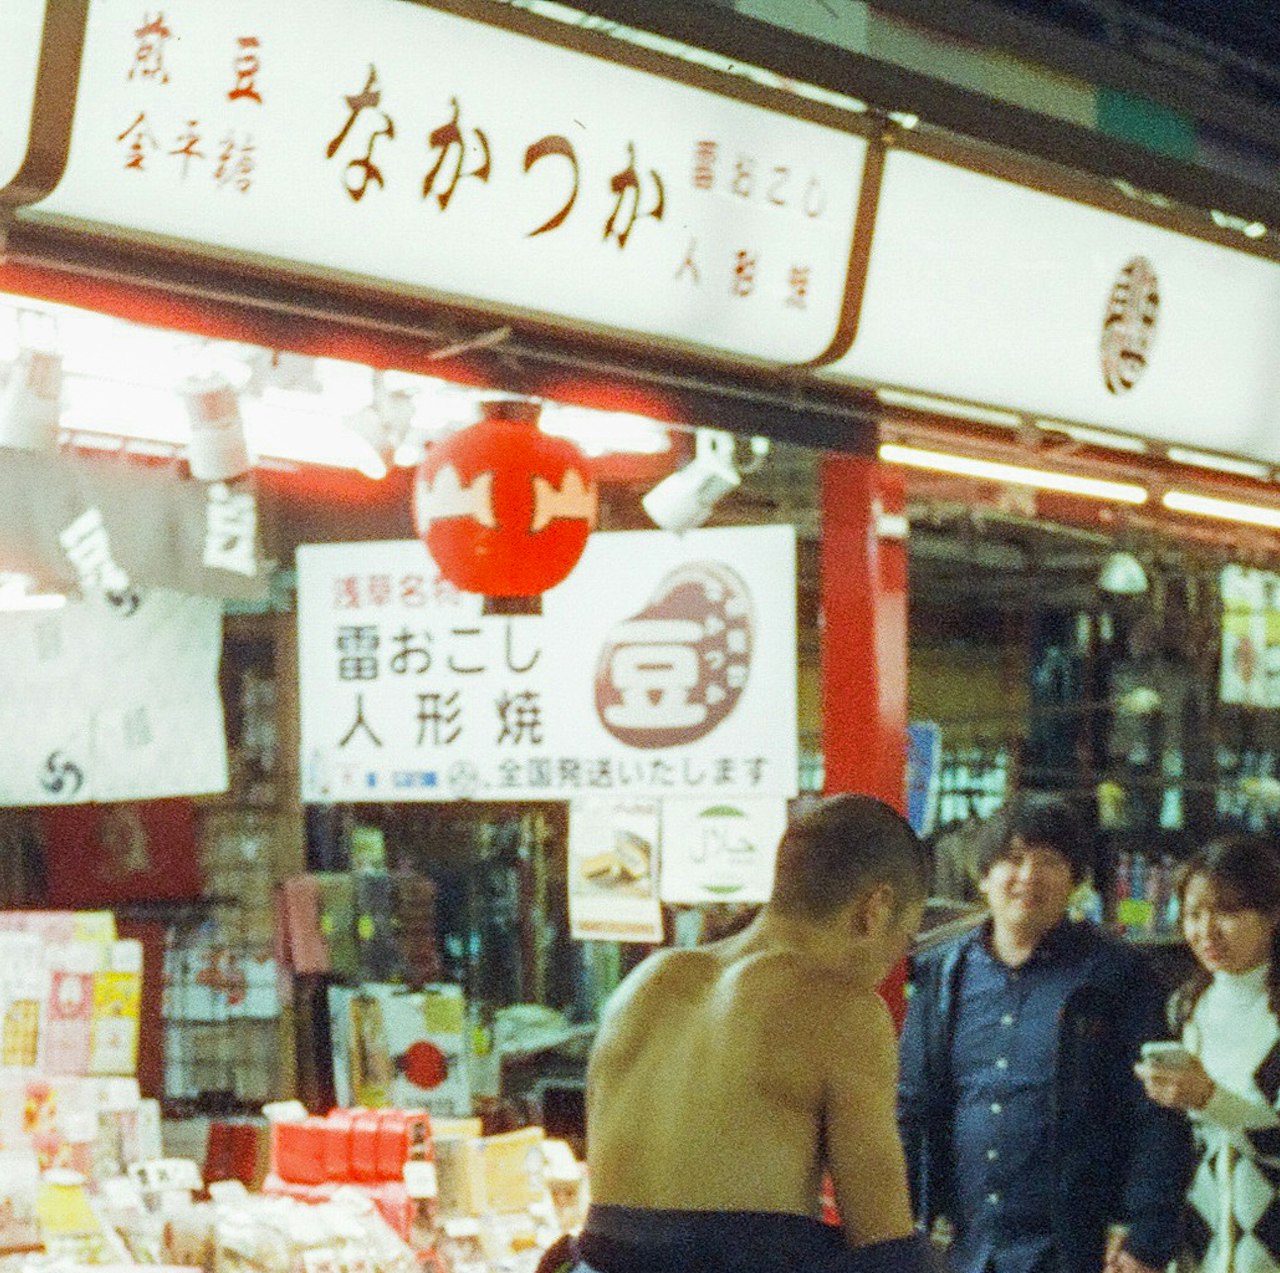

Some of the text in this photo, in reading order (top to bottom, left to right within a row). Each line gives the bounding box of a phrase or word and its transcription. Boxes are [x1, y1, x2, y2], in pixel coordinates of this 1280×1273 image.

[327, 64, 665, 250] なかつか
[336, 618, 543, 682] 雷おこし
[339, 691, 544, 748] 人形焼
